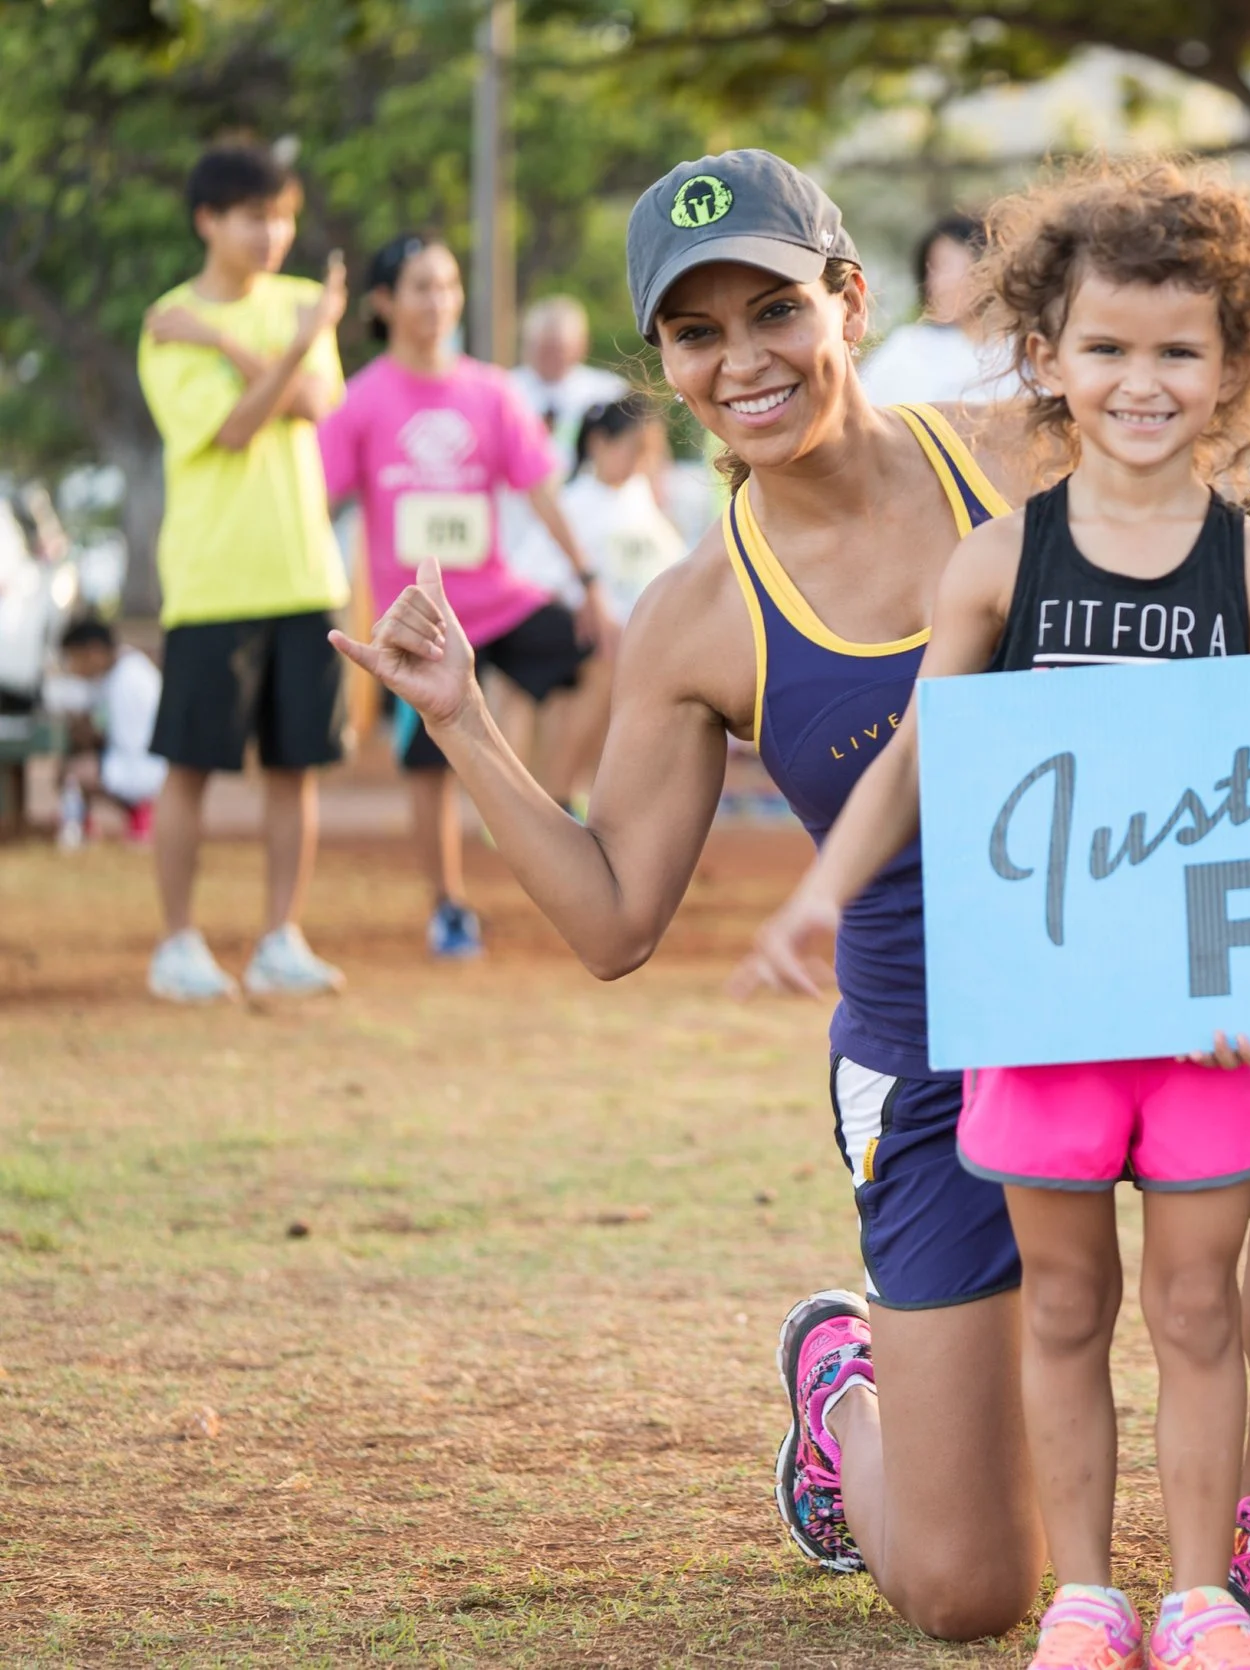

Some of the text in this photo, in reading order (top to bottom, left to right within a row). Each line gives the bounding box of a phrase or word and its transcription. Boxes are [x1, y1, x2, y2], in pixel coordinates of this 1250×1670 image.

[1037, 599, 1227, 659] FIT FOR A
[830, 712, 901, 760] LIVE
